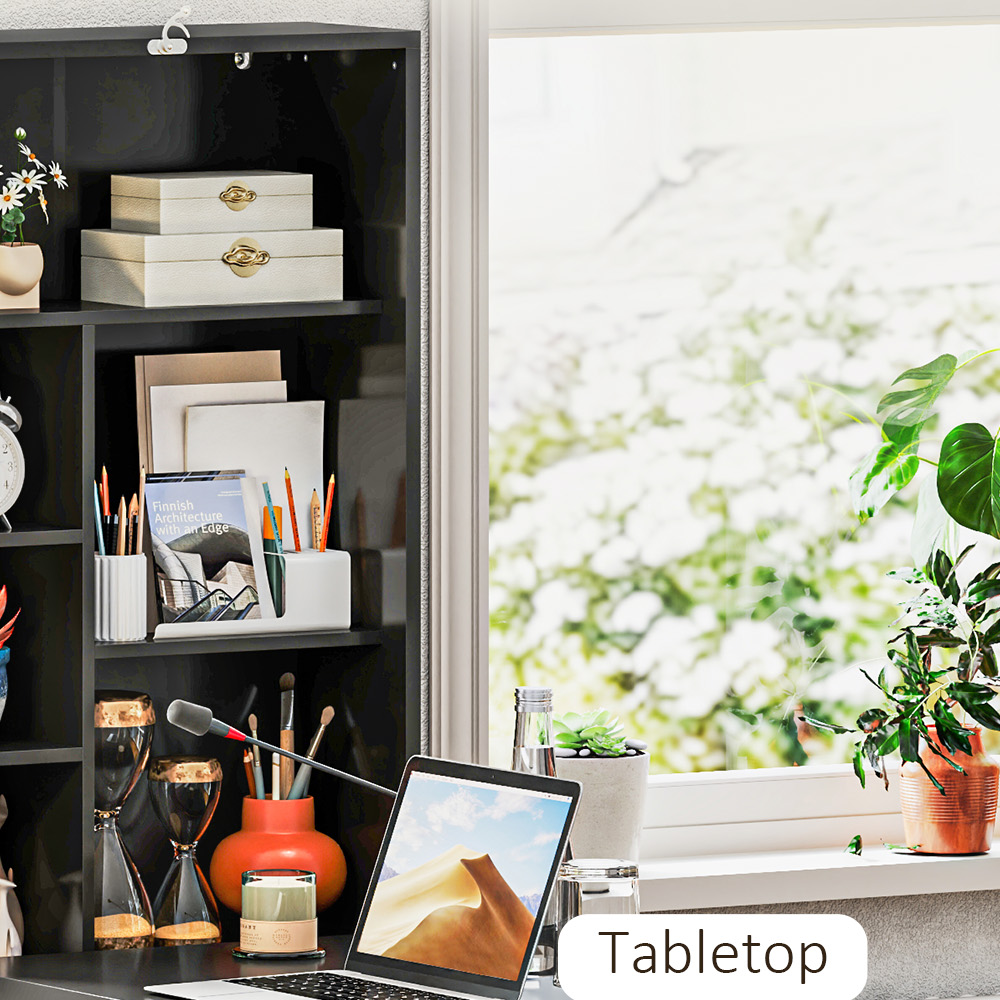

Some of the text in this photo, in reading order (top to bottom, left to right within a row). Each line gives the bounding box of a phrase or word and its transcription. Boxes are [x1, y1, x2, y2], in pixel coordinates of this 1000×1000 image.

[2, 444, 8, 454] 2
[8, 461, 13, 472] 3
[4, 480, 9, 490] 4
[152, 501, 194, 512] Finnish
[155, 512, 223, 524] Architecture
[156, 523, 229, 535] with an Edge
